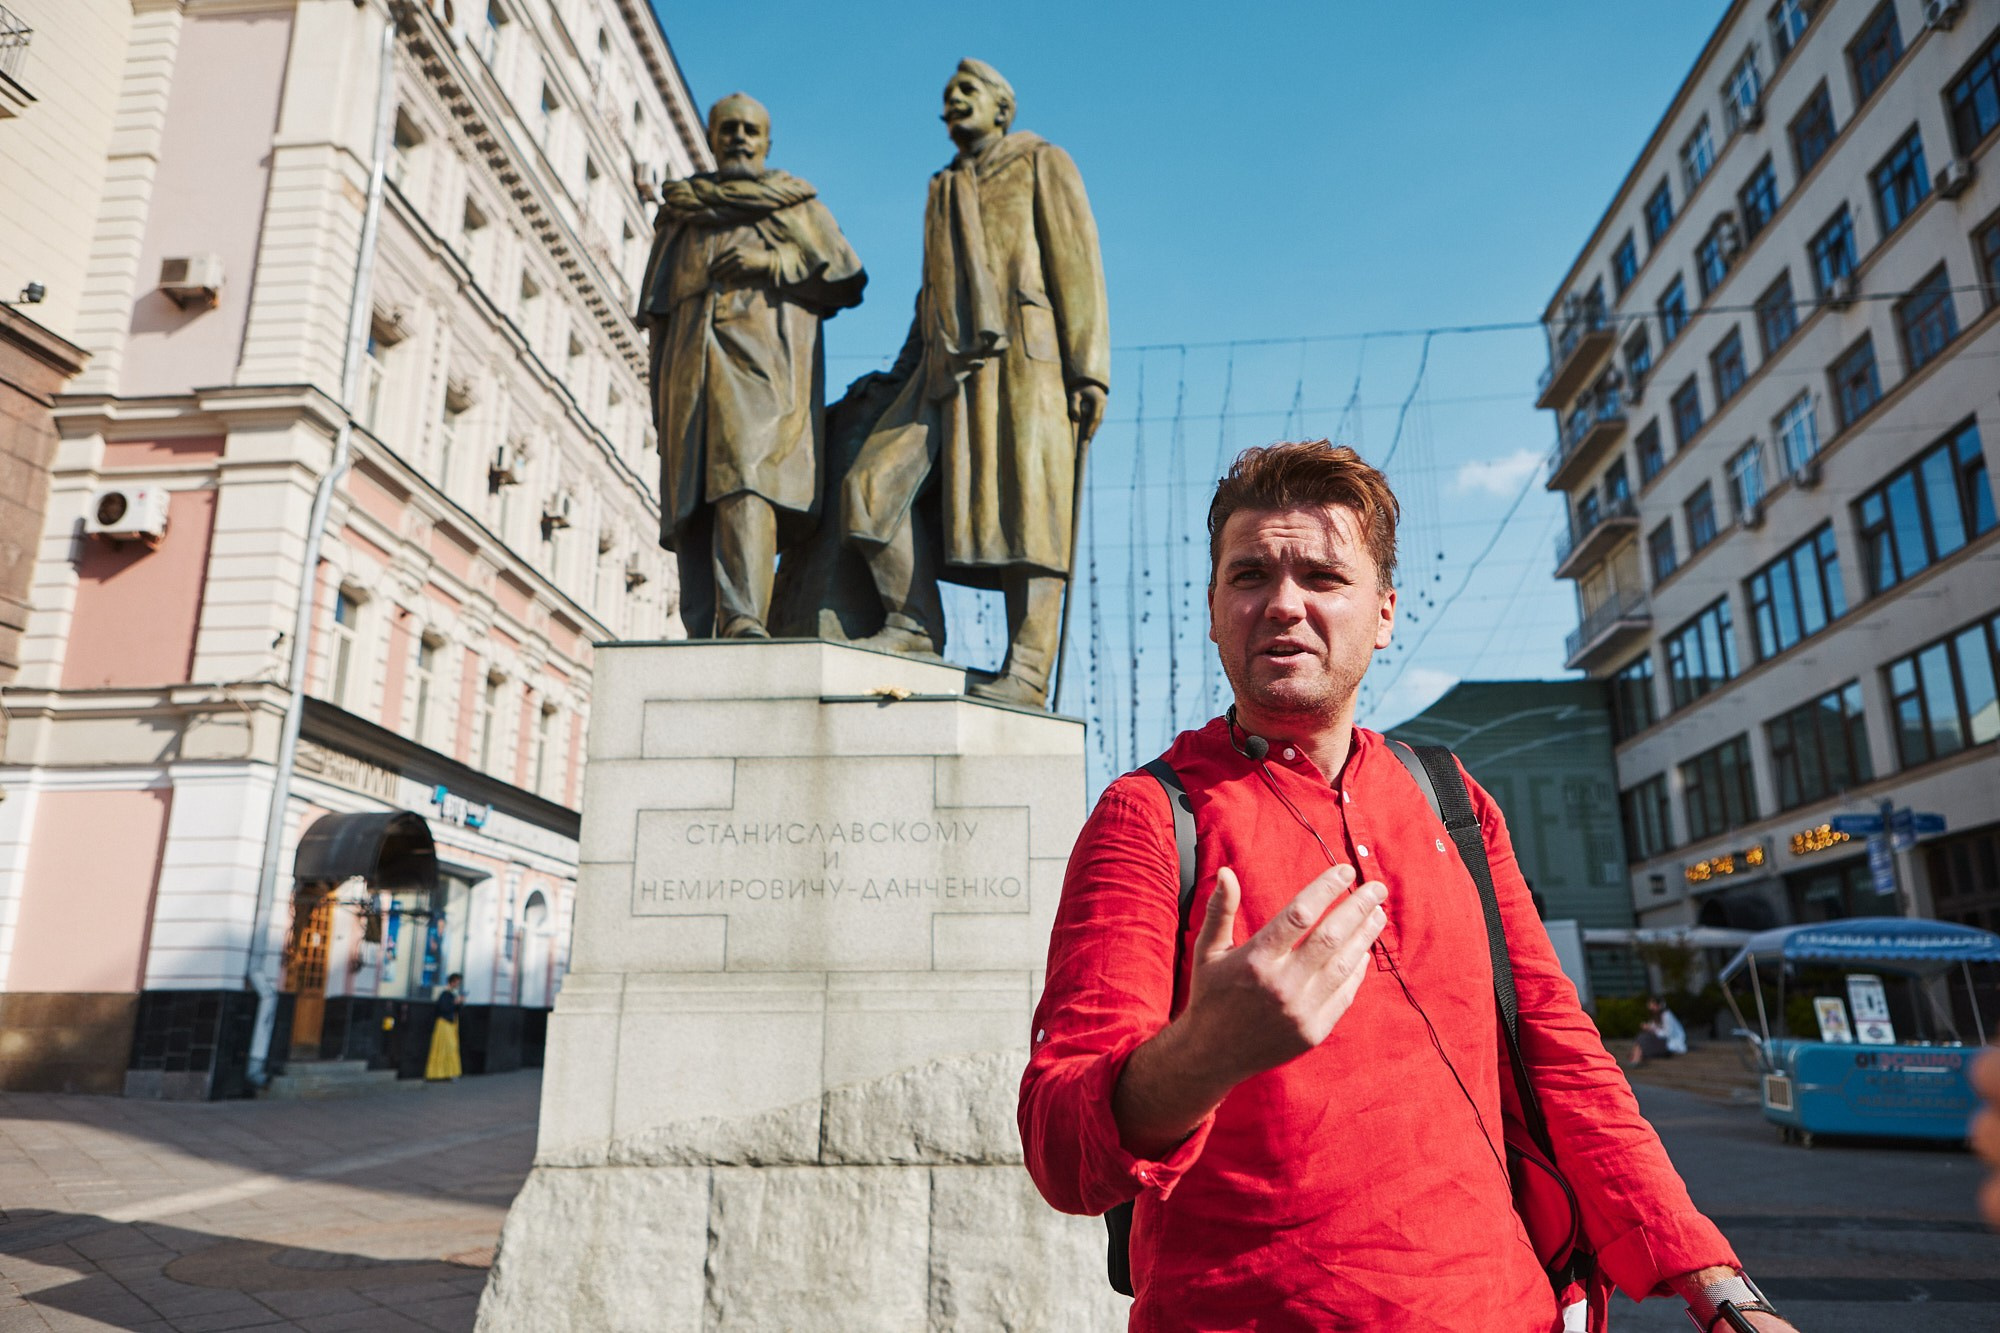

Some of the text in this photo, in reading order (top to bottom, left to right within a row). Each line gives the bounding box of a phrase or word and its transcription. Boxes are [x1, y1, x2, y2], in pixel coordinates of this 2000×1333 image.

[686, 821, 979, 847] СТАНИСЛАВСКОМУ
[823, 851, 839, 870] И
[640, 876, 1022, 902] НЕМИРОВИЧУ-ДАНЧЕНКО
